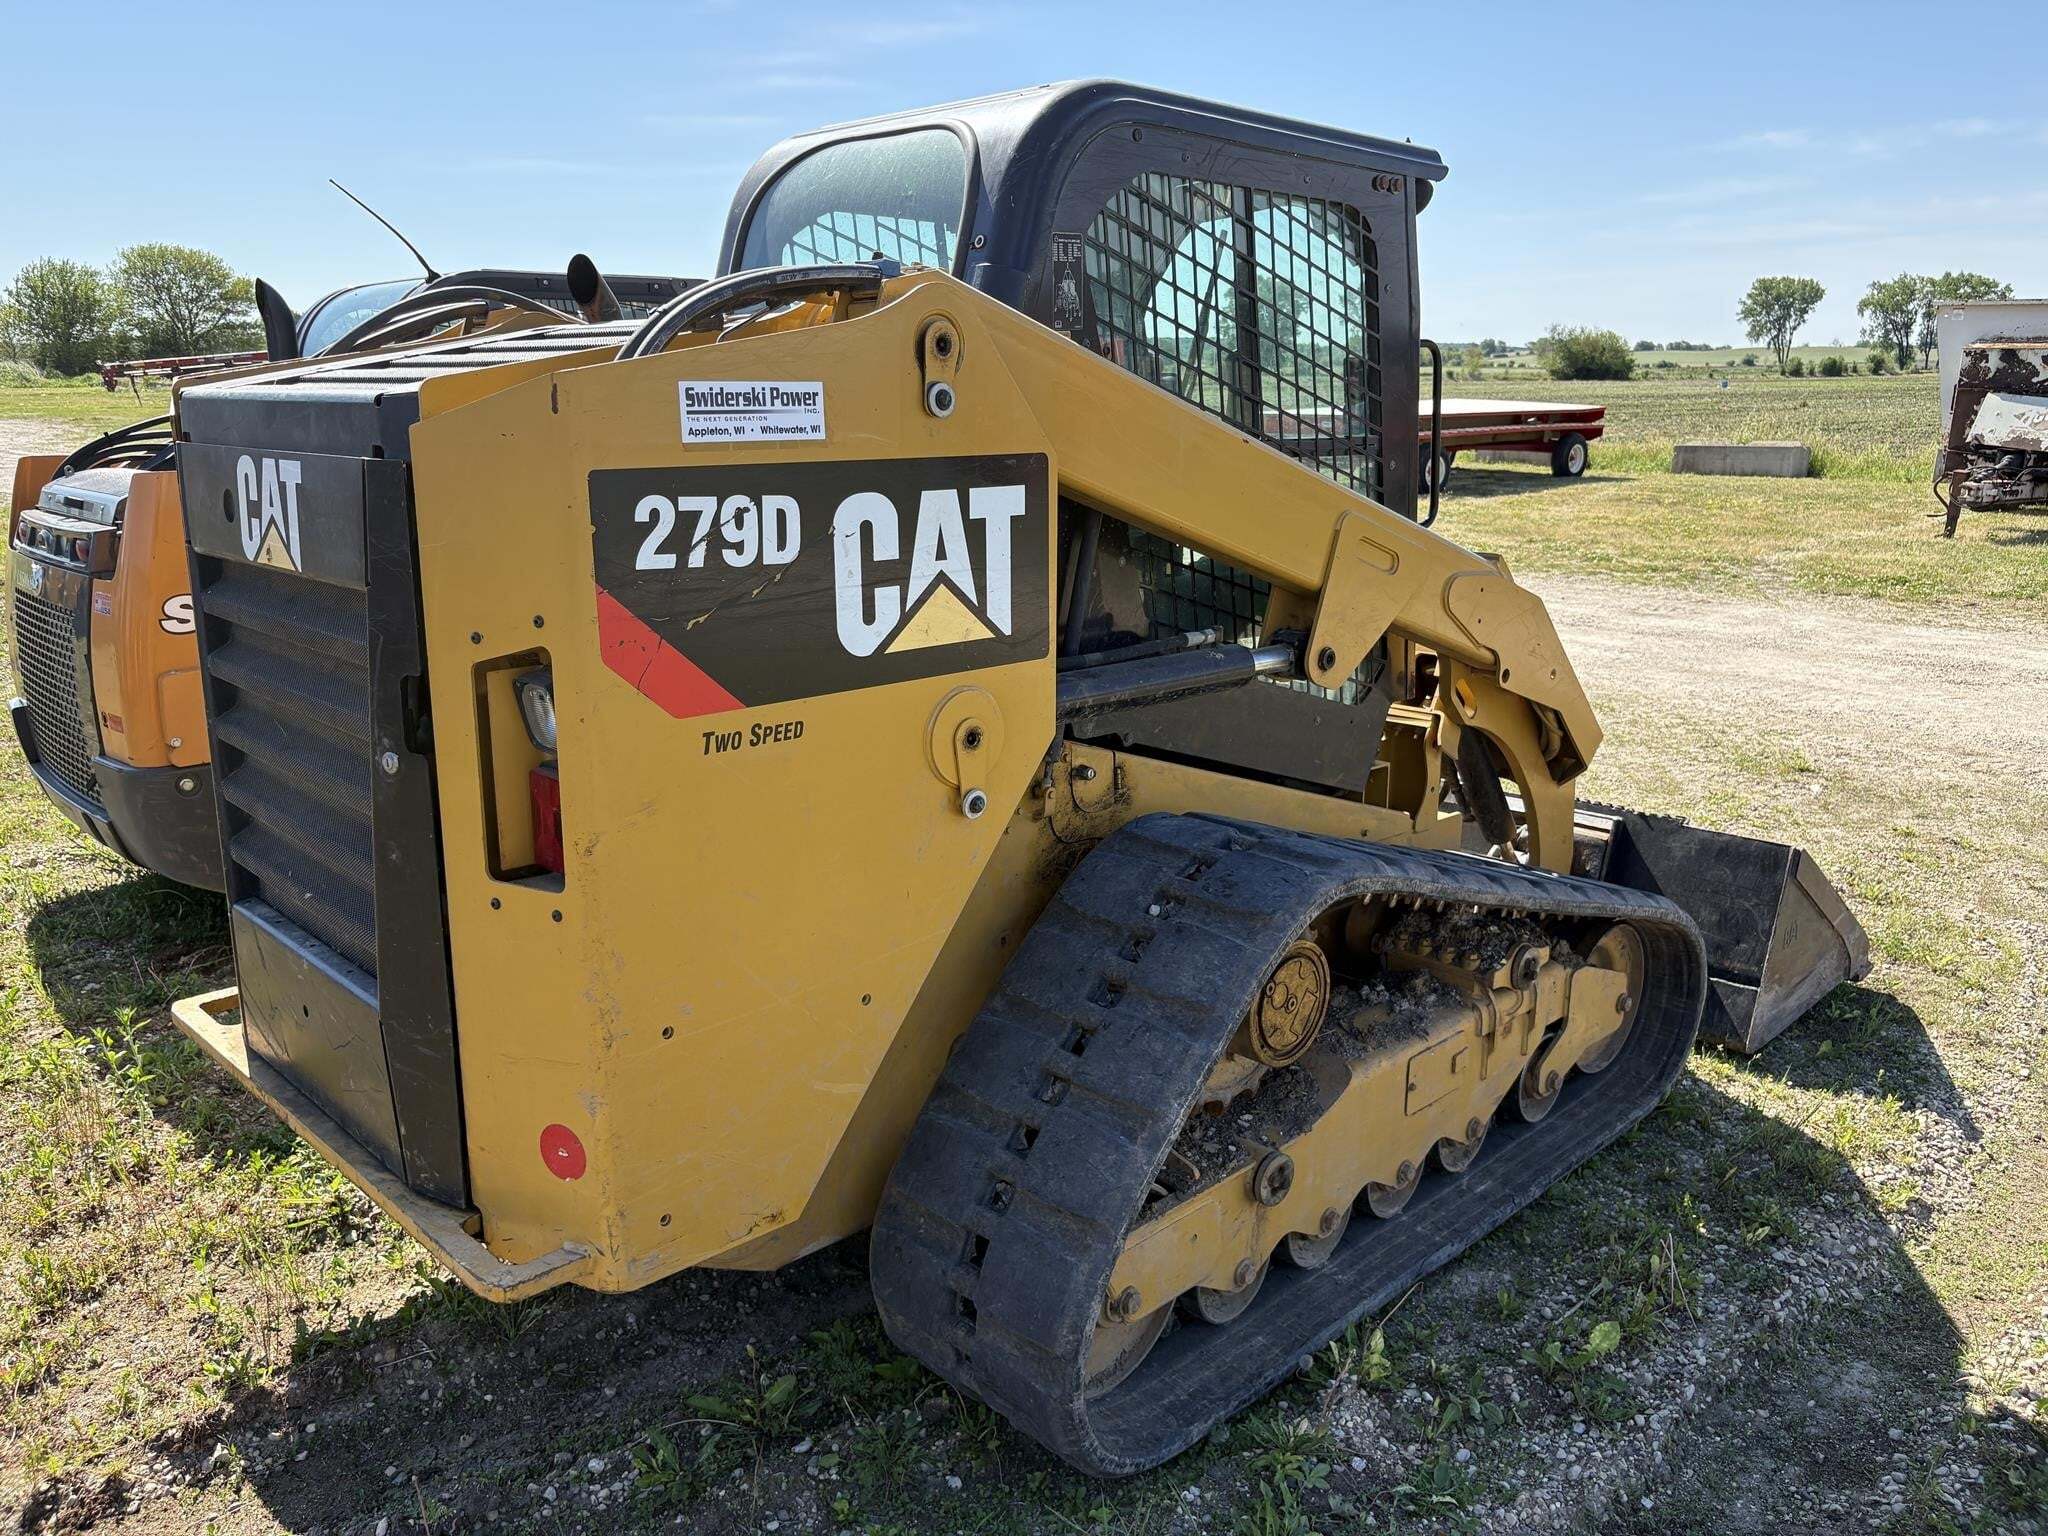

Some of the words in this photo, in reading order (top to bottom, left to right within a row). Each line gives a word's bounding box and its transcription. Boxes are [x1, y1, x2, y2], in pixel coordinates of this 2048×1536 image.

[685, 386, 766, 408] Swiderski
[769, 386, 819, 407] Power
[688, 426, 732, 438] Appleton,
[734, 426, 745, 435] WI
[760, 425, 809, 435] Whitewater,
[810, 424, 821, 434] WI
[237, 454, 302, 573] CAT
[634, 494, 800, 571] 279D
[833, 484, 1026, 658] CAT
